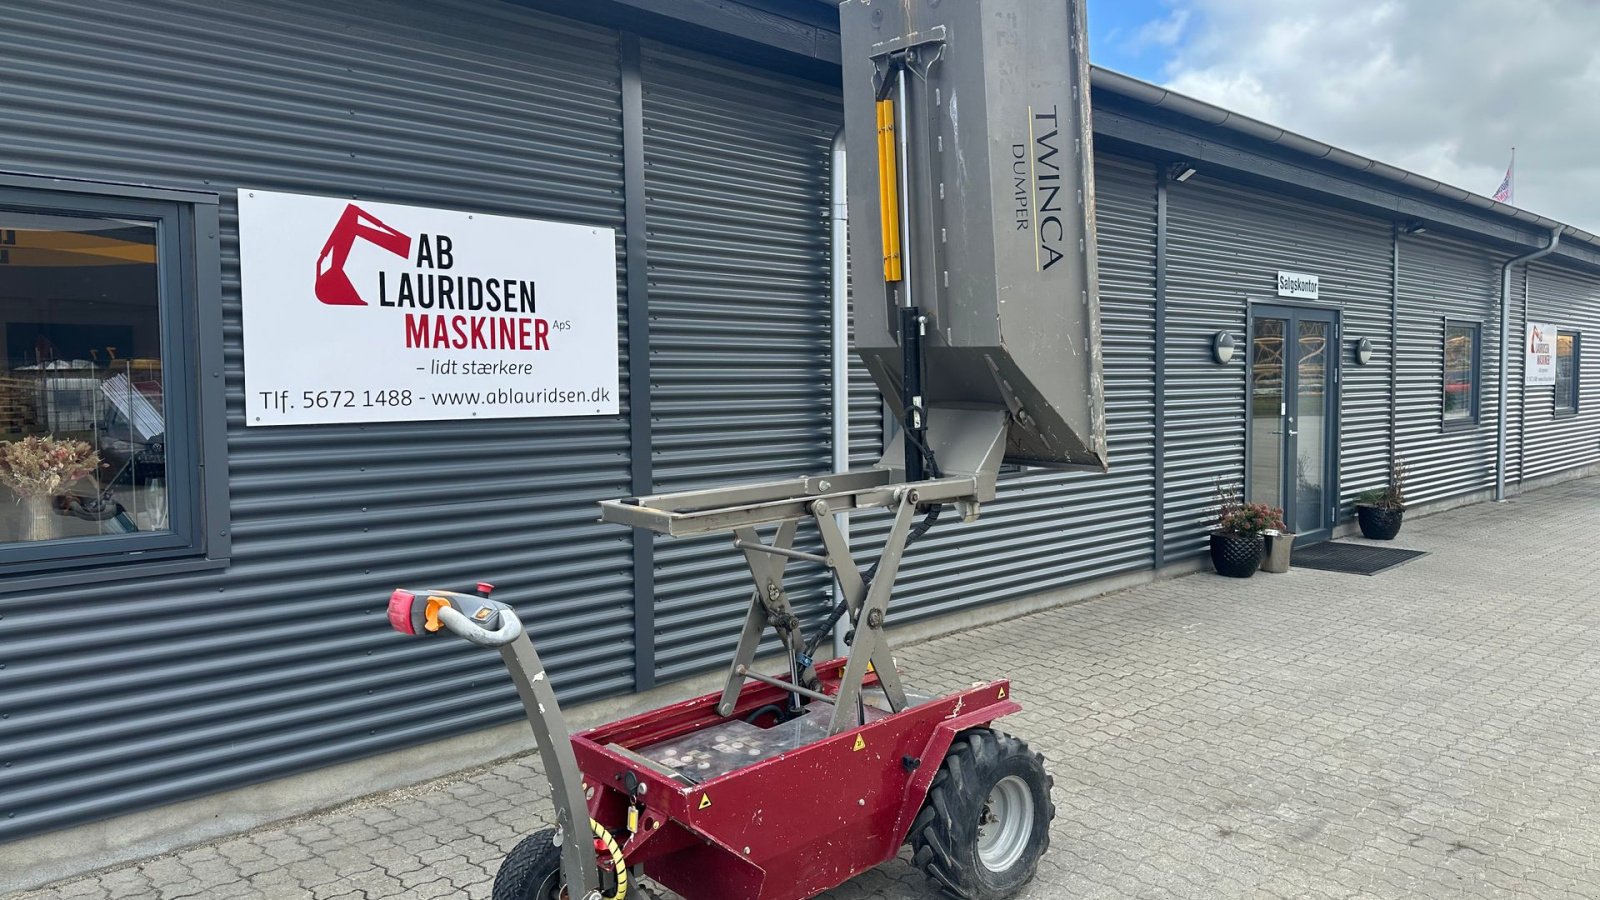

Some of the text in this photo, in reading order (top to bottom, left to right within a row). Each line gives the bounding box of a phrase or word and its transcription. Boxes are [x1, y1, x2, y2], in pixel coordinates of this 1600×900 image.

[1012, 144, 1029, 231] DUMPER
[1036, 105, 1064, 271] TWINCA
[416, 233, 454, 270] AB
[379, 271, 536, 313] LAURIDSEN
[1279, 275, 1317, 294] Salgskontor
[405, 313, 571, 351] MASKINER ApS
[431, 359, 458, 375] lidt
[462, 359, 533, 375] stærkere
[259, 390, 295, 414] Tlf.
[303, 390, 356, 409] 5672
[362, 389, 413, 407] 1488
[431, 387, 610, 406] www.ablauridsen.dk
